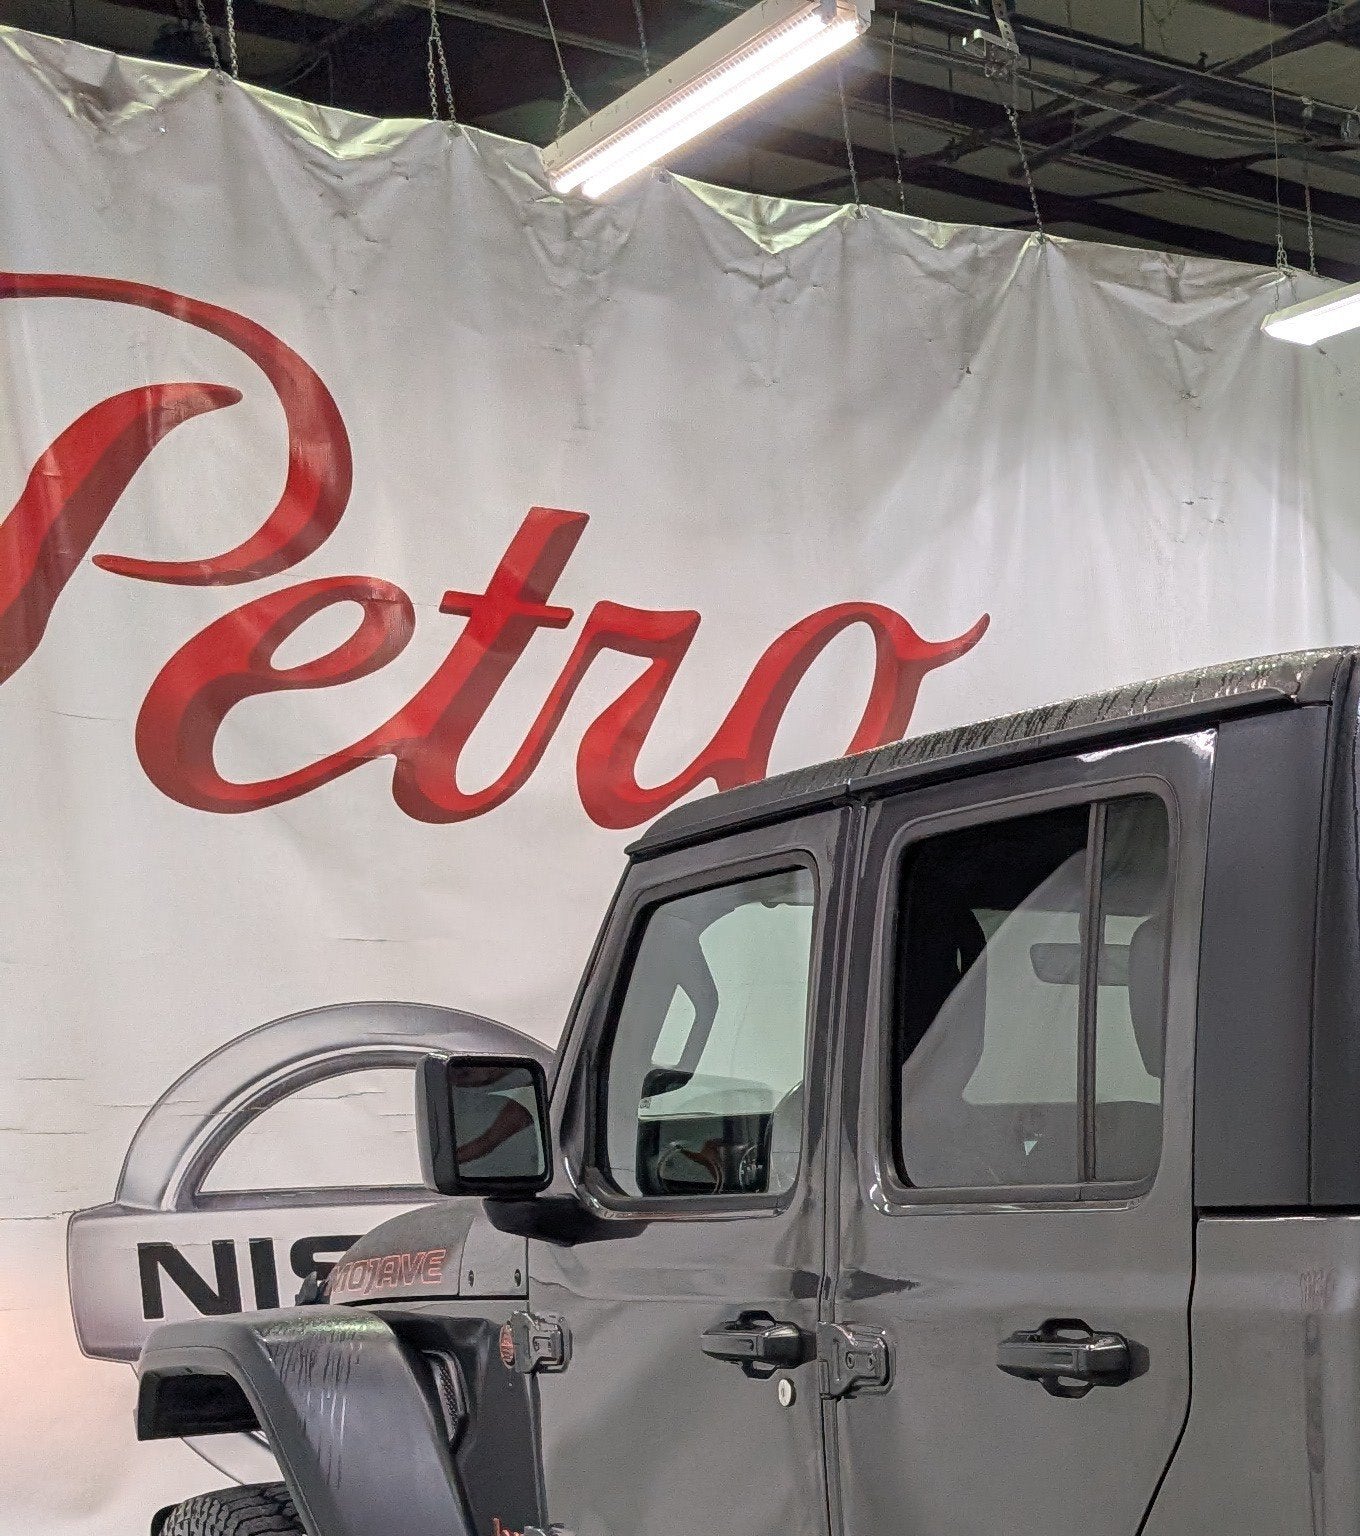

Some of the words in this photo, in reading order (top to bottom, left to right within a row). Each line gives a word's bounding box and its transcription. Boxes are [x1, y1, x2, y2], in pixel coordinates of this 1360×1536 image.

[0, 272, 991, 830] Petro
[137, 1235, 366, 1320] NIS
[324, 1249, 447, 1296] MOJAVE
